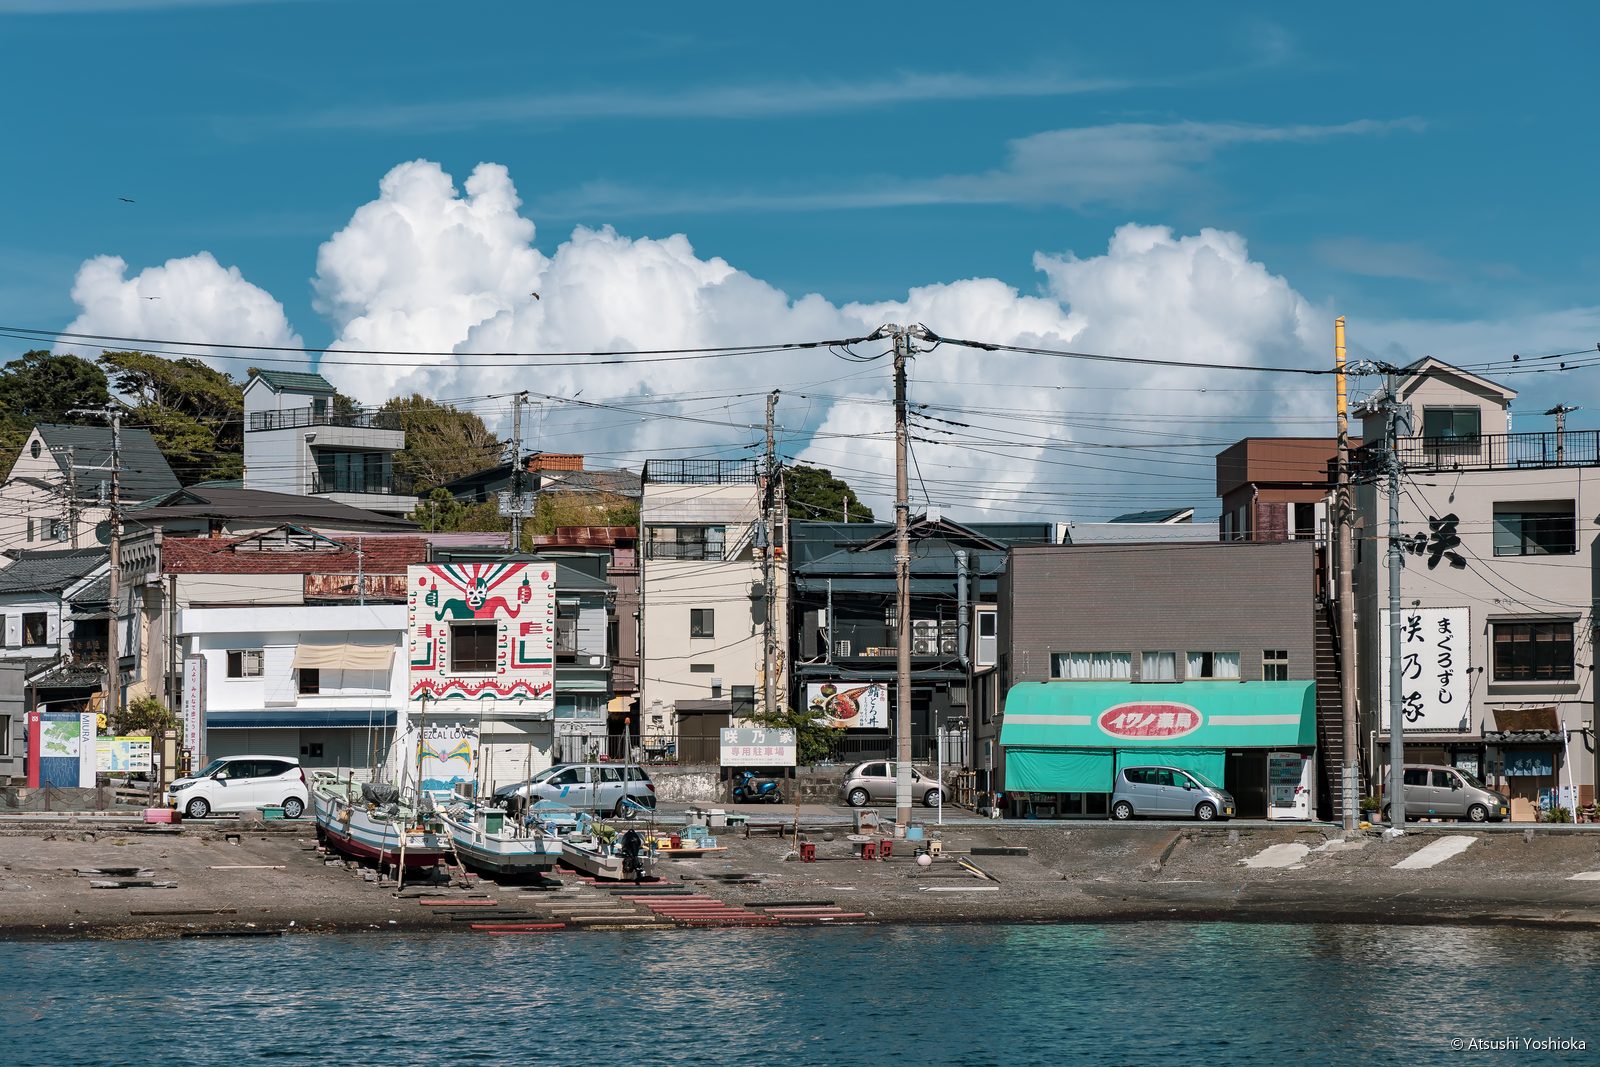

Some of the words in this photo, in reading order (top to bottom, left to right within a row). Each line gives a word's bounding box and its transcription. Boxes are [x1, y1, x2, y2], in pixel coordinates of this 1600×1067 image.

[1437, 617, 1453, 704] まぐろずし
[82, 714, 90, 743] MIURA
[724, 730, 793, 744] 咲乃家
[731, 747, 785, 757] 専用駐車場
